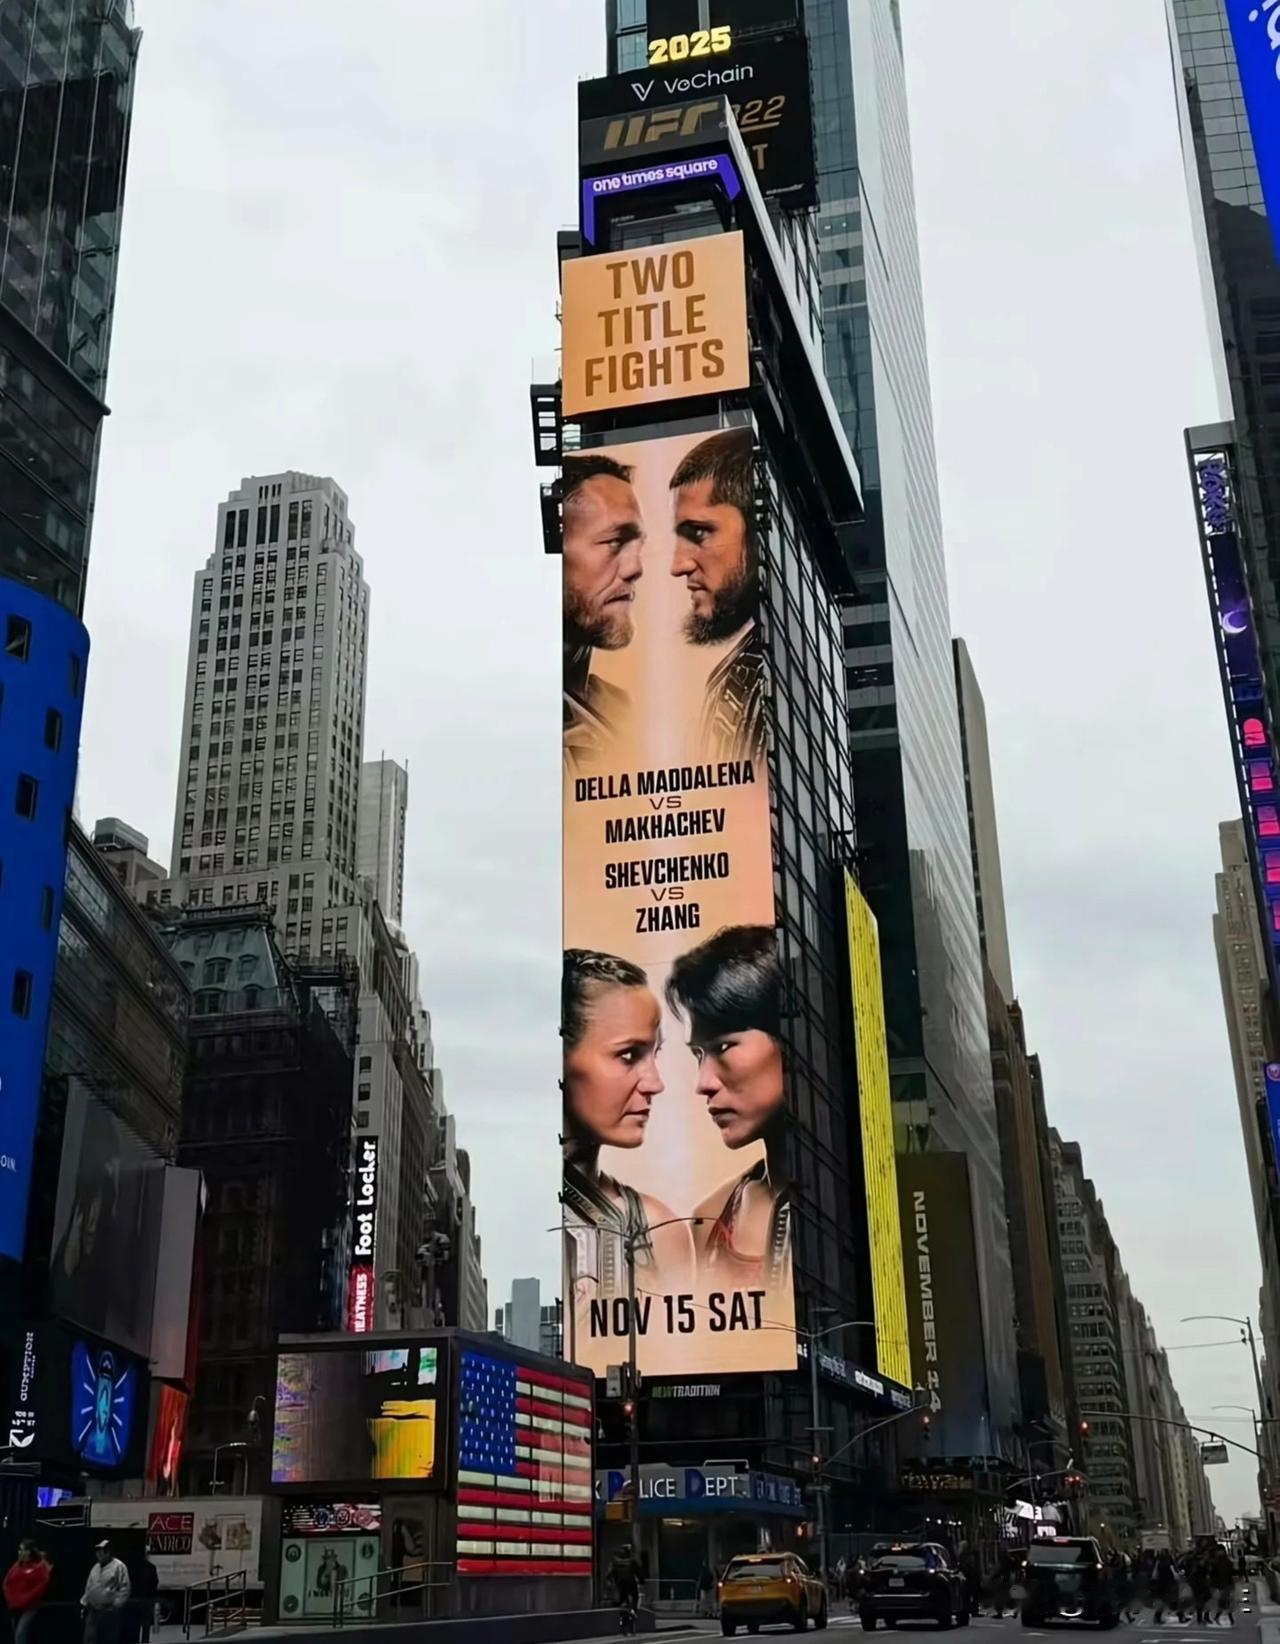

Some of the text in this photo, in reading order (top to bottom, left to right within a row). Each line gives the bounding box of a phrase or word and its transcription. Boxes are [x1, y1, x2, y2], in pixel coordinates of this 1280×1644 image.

[648, 25, 732, 65] 2025
[664, 64, 754, 94] VeChain
[593, 159, 718, 192] one times square
[605, 250, 695, 299] TWO
[597, 294, 707, 348] TITLE
[585, 338, 725, 397] FIGHTS
[575, 760, 755, 802] DELLA MADDALENA
[649, 795, 682, 810] VS
[605, 808, 726, 844] MAKHACHEV
[605, 852, 730, 889] SHEVCHENKO
[650, 886, 684, 902] VS
[635, 903, 700, 933] ZHANG
[355, 1141, 376, 1256] Foot Locker
[913, 1191, 937, 1362] NOVEMBER
[590, 1291, 766, 1338] NOV 15 SAT
[150, 1514, 193, 1531] ACE
